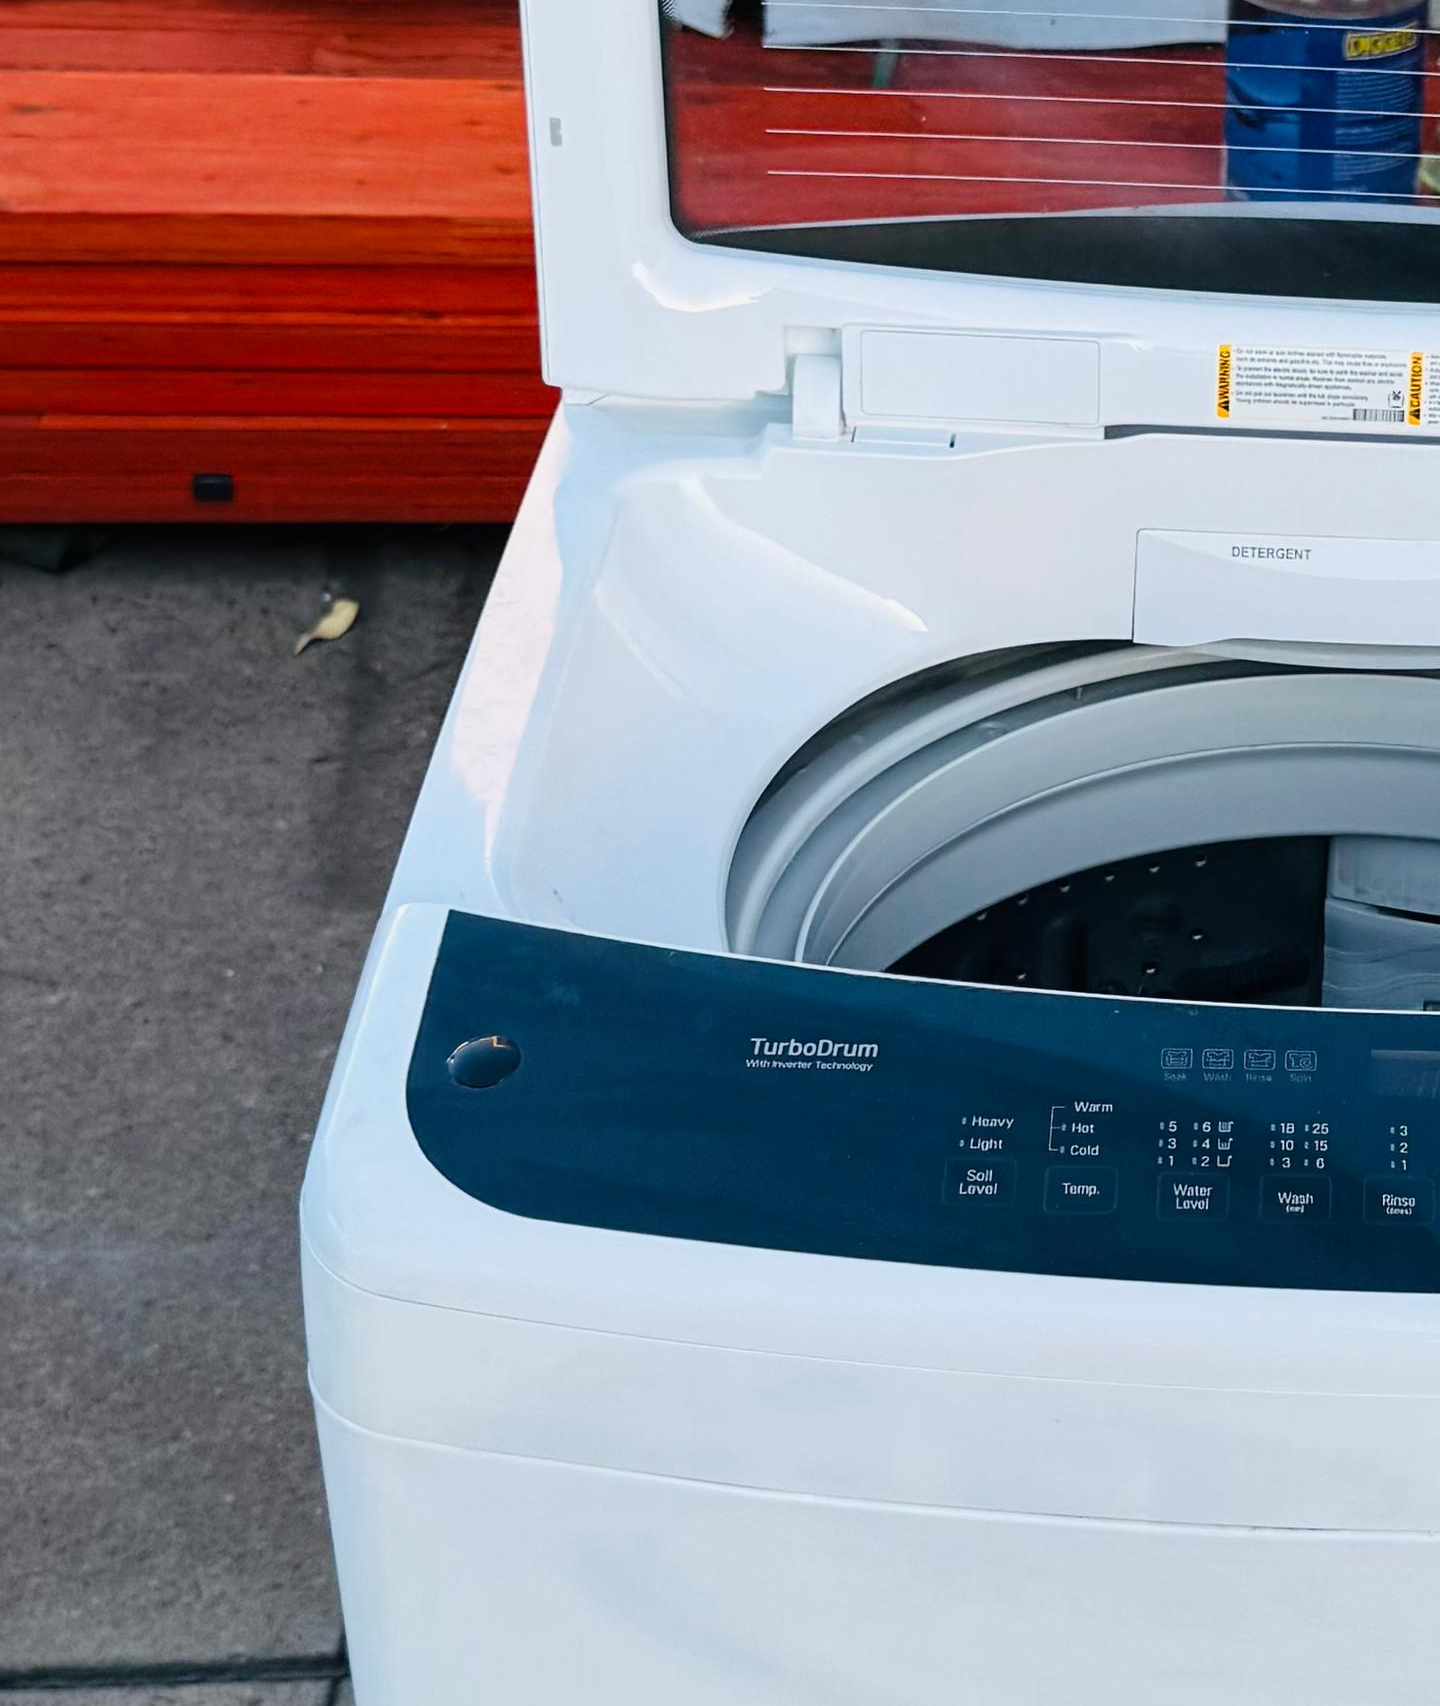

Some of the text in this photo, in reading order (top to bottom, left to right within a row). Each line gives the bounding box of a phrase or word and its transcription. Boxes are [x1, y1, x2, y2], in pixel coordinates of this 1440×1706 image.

[1218, 351, 1230, 400] WARNING
[1410, 356, 1422, 408] CAUTION
[1231, 545, 1312, 560] DETERGENT
[750, 1037, 879, 1058] TurboDrum
[746, 1059, 874, 1073] With Inverter Technology
[1073, 1101, 1114, 1113] Warm
[971, 1115, 1015, 1130] Heavy
[1071, 1122, 1095, 1134] Hot
[1168, 1120, 1212, 1133] 5 6
[1311, 1122, 1330, 1135] 25
[1399, 1124, 1409, 1137] 3
[969, 1137, 1003, 1152] Light
[1070, 1144, 1100, 1156] Cold
[1167, 1137, 1211, 1150] 3 4
[1280, 1139, 1329, 1152] 10 15
[1399, 1142, 1409, 1154] 2
[1168, 1155, 1210, 1167] 1 2
[1281, 1156, 1291, 1169] 3
[1401, 1159, 1408, 1171] 1
[966, 1168, 994, 1183] Soil
[959, 1182, 999, 1196] Level
[1061, 1181, 1101, 1198] Temp.
[1172, 1183, 1214, 1197] Water
[1175, 1197, 1210, 1211] Level
[1277, 1190, 1315, 1205] Wash
[1382, 1193, 1416, 1208] Rinse
